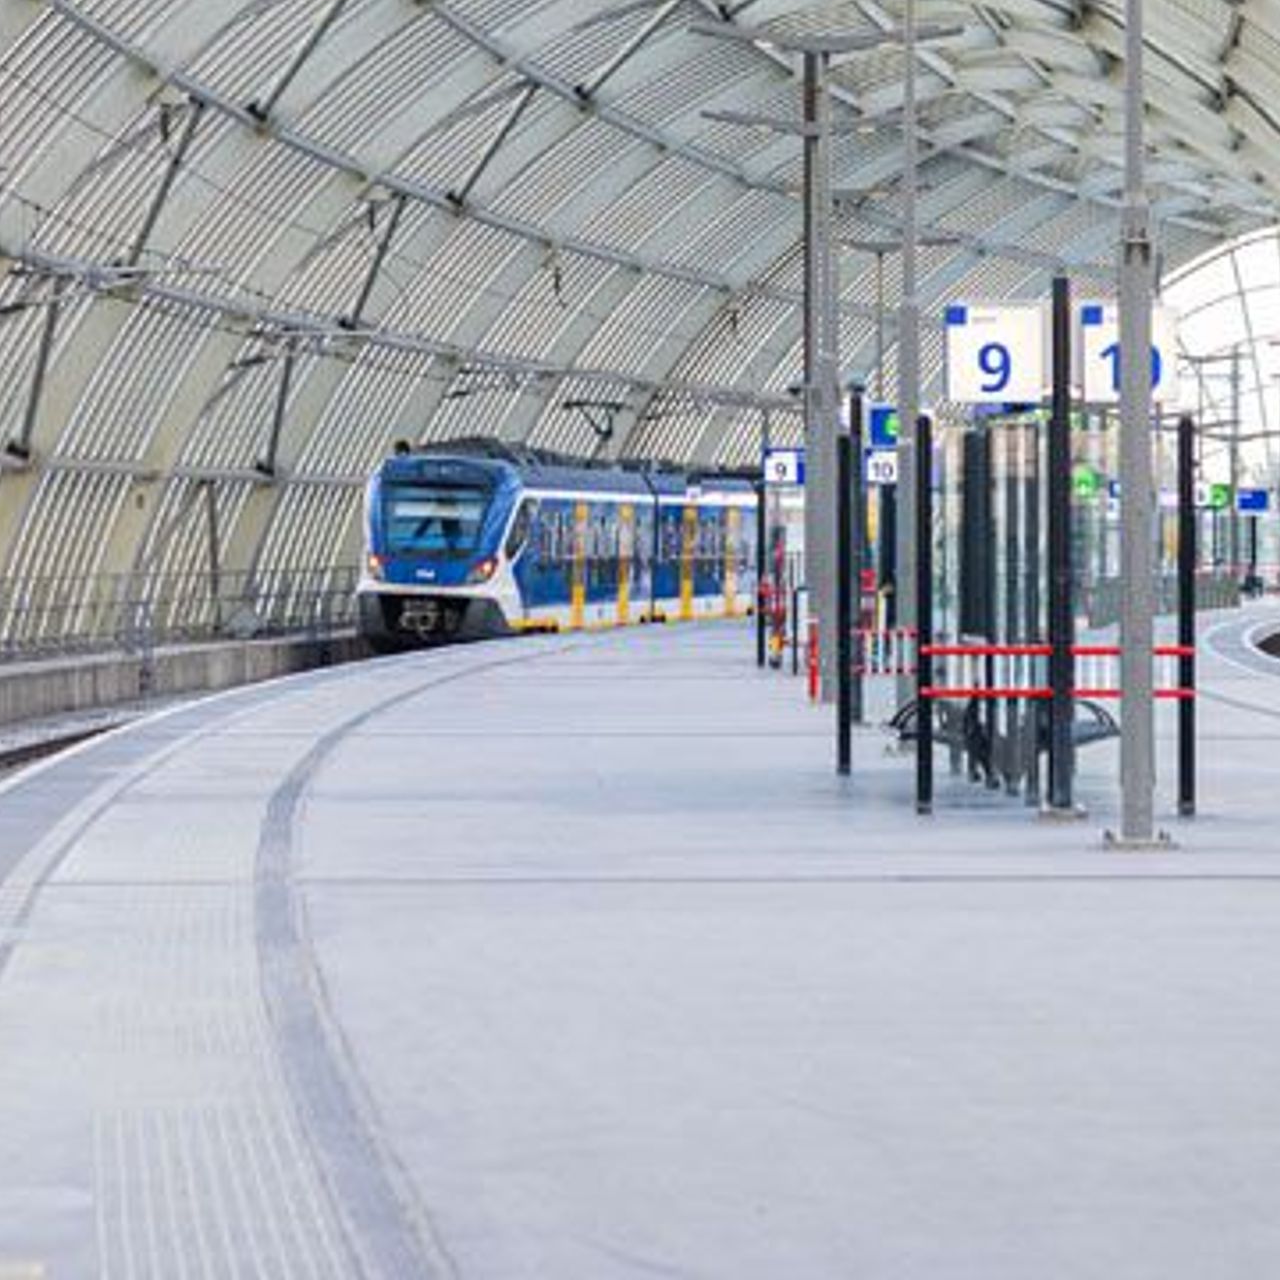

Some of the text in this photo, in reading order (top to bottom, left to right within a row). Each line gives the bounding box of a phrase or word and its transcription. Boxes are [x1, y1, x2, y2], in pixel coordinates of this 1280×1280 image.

[978, 343, 1011, 392] 9
[775, 462, 787, 480] 9
[872, 461, 894, 480] 10
